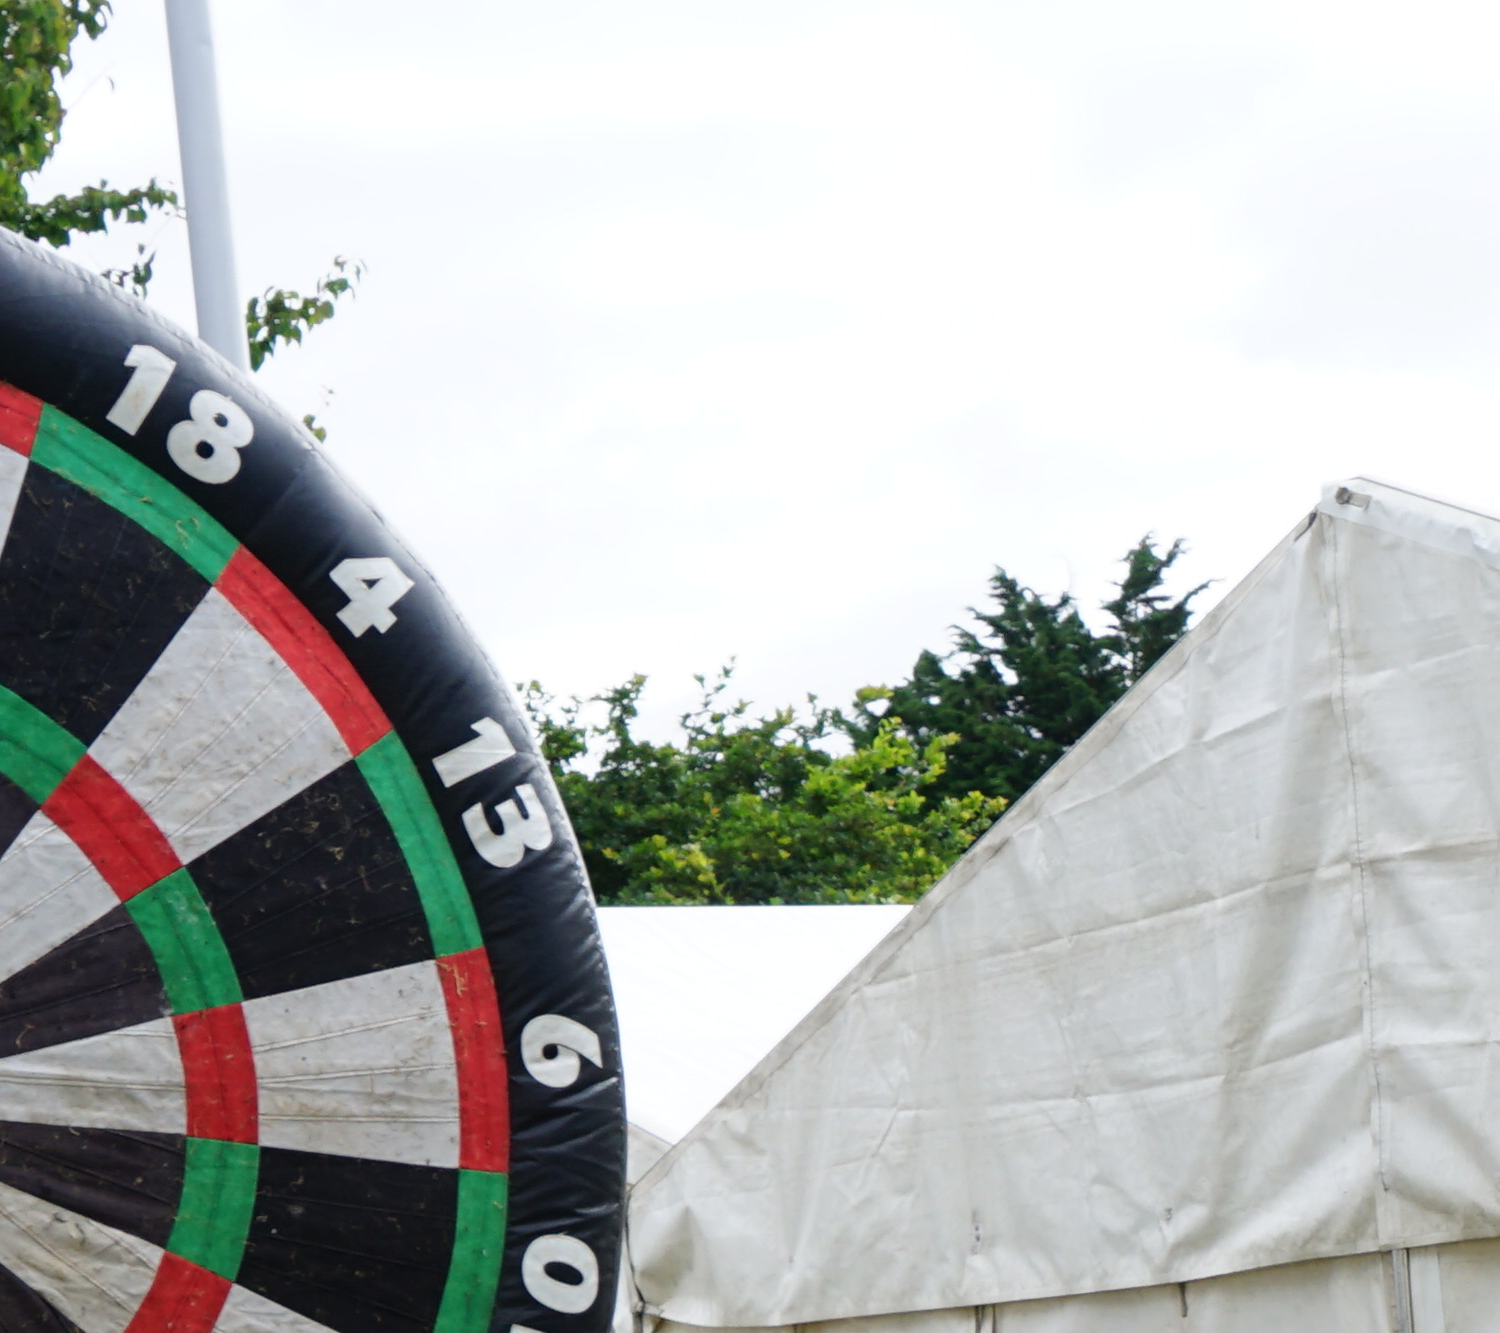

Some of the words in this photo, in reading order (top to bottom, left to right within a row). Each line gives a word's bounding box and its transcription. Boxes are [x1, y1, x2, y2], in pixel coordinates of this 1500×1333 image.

[105, 343, 256, 485] 18
[329, 557, 414, 638] 4
[432, 716, 553, 869] 13
